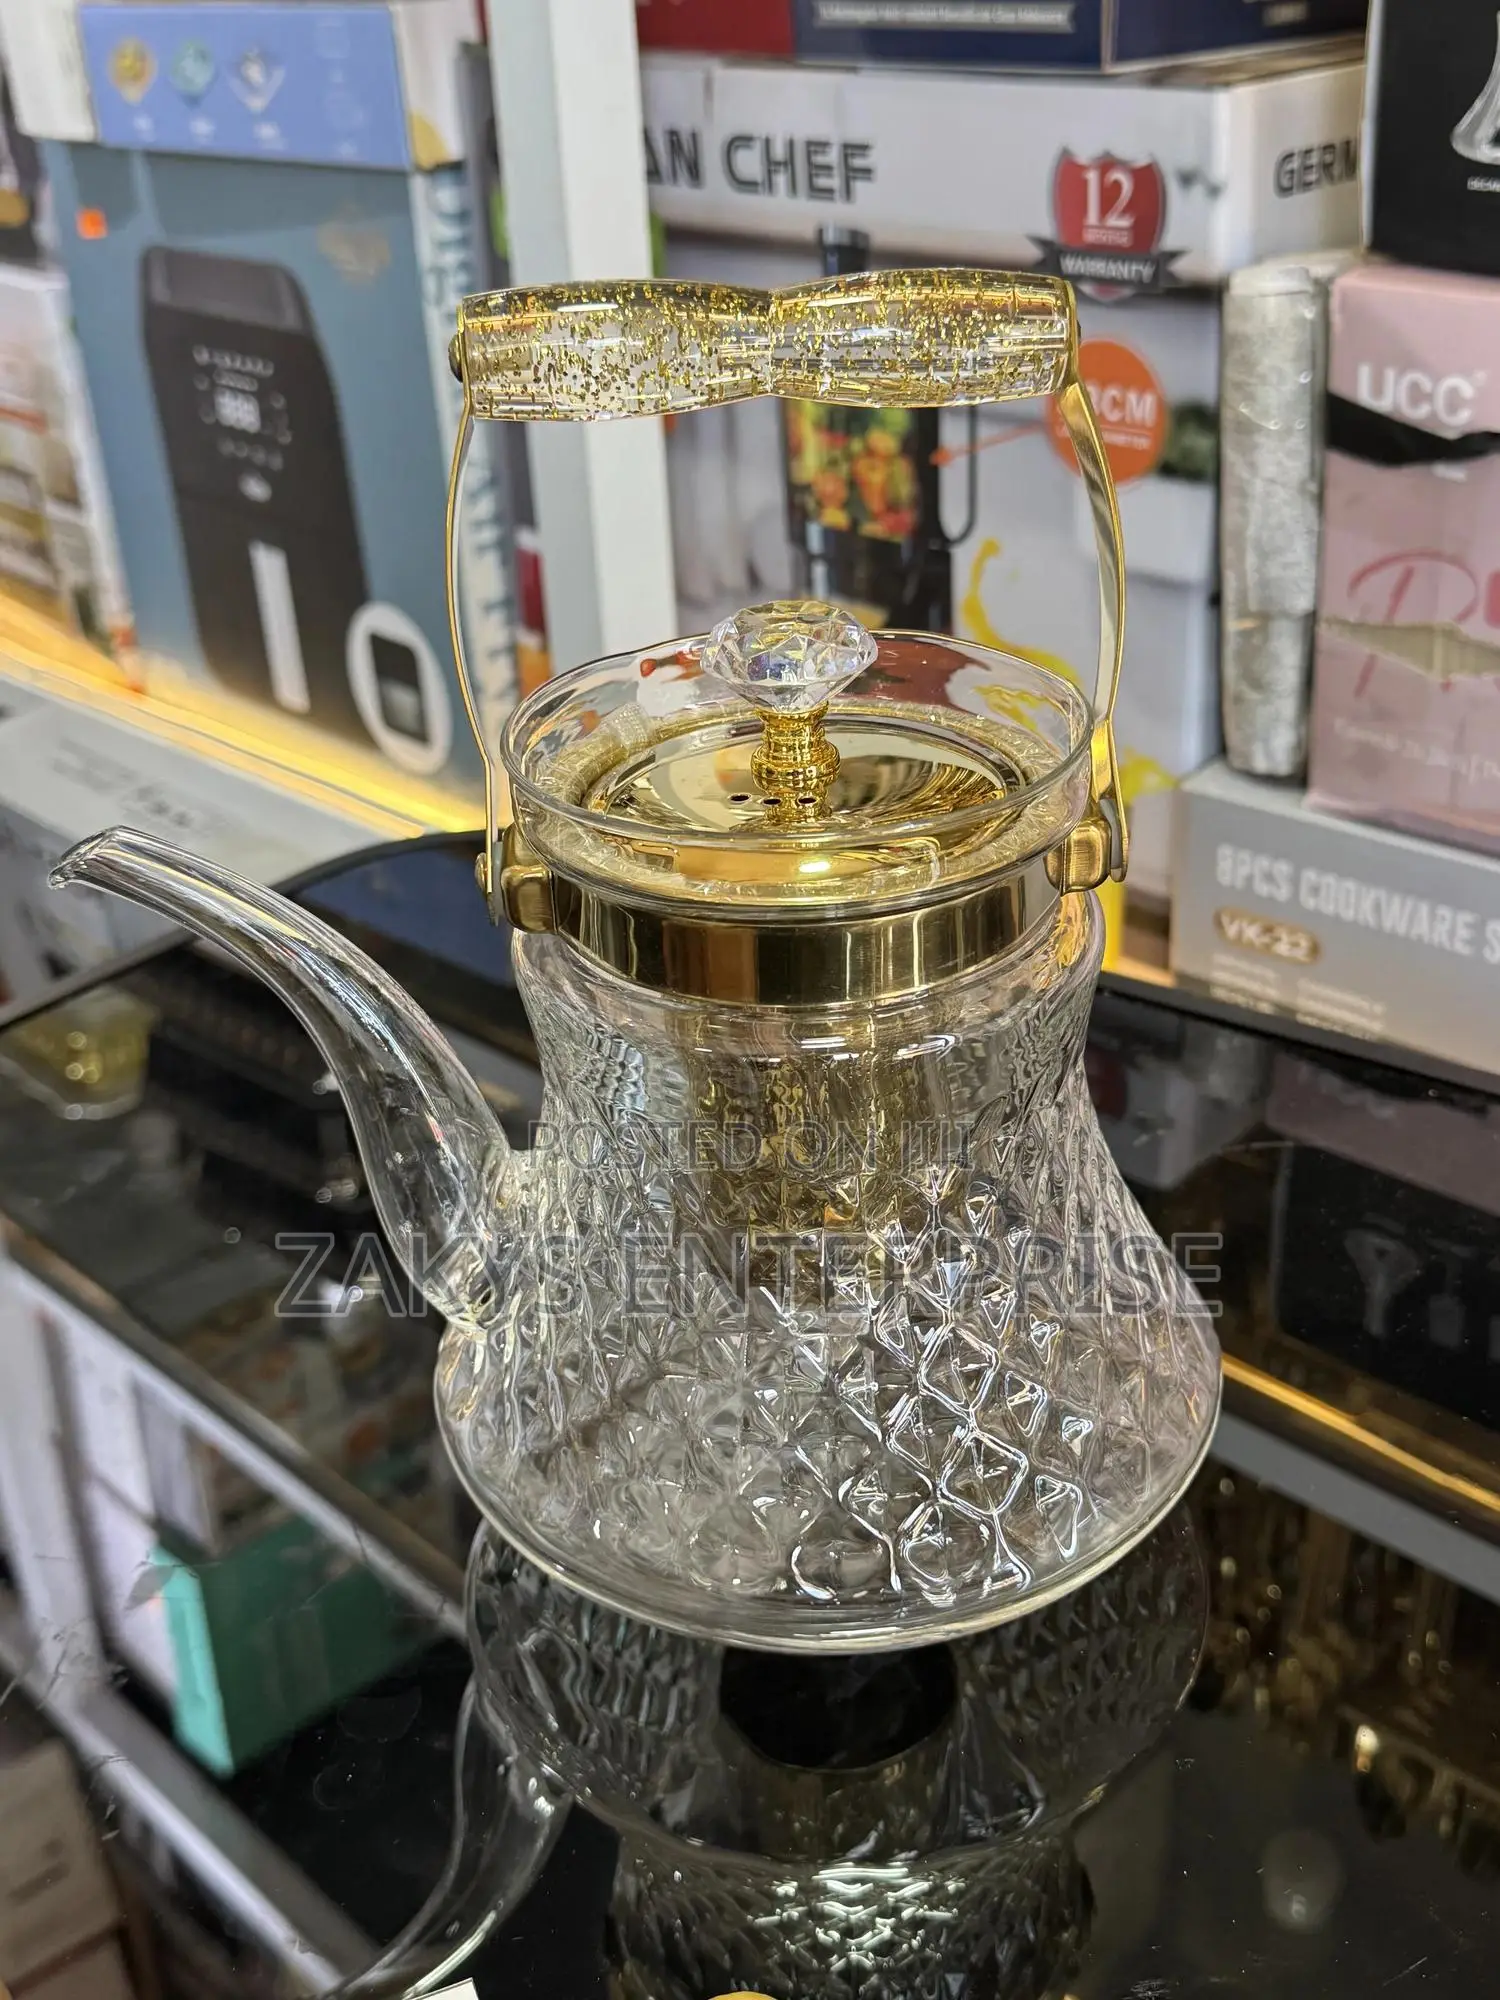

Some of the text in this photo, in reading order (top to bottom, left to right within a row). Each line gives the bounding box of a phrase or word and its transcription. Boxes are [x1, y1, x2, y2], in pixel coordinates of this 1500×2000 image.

[724, 133, 877, 204] CHEF
[1082, 167, 1137, 228] 12
[1060, 252, 1157, 283] WARRANTY
[1357, 364, 1475, 427] UCC
[1299, 867, 1481, 956] COOKWARE
